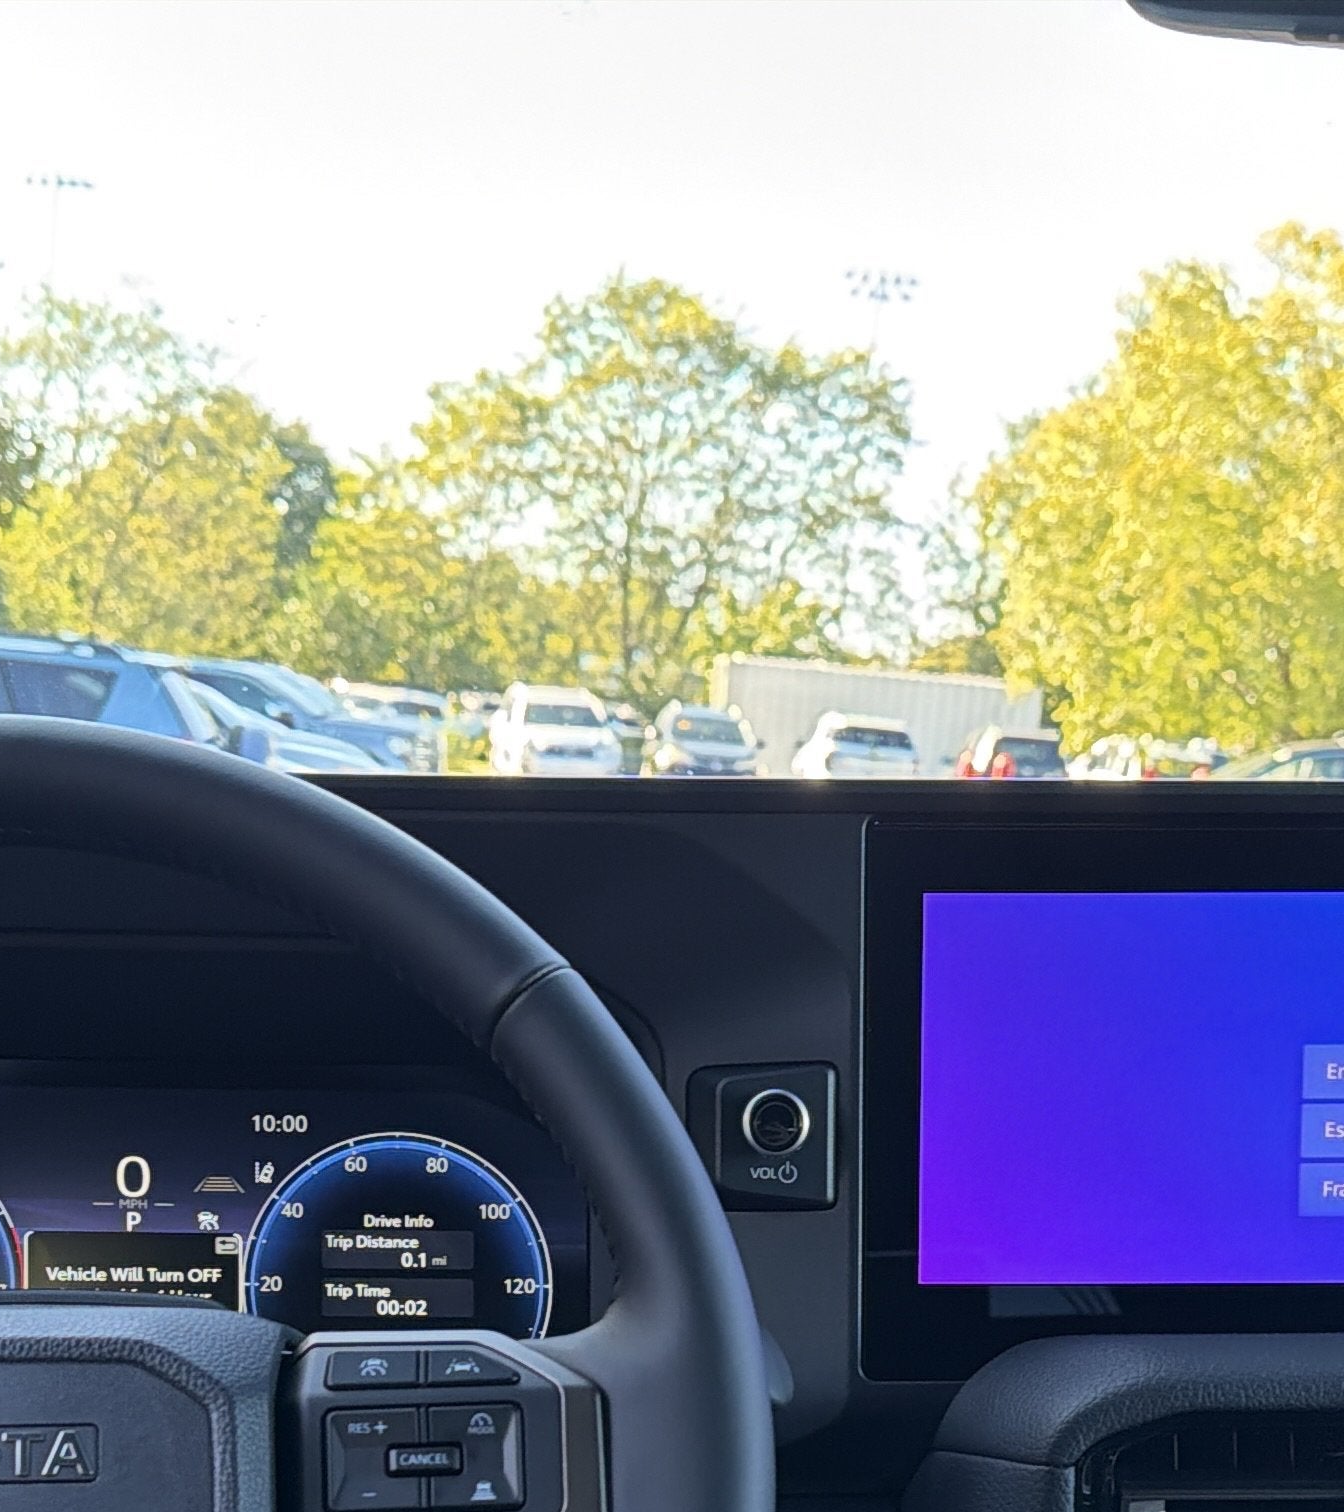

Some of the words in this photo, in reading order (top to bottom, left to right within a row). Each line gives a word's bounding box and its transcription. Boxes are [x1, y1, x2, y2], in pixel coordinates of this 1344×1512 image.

[251, 1114, 308, 1133] 10:00
[344, 1156, 368, 1174] 60
[425, 1157, 449, 1174] 80
[750, 1167, 777, 1180] VOL
[116, 1155, 151, 1198] 0
[118, 1199, 149, 1210] MPH
[281, 1201, 304, 1219] 40
[478, 1203, 511, 1221] 100
[126, 1211, 142, 1232] P
[364, 1213, 401, 1228] Drive
[403, 1213, 434, 1228] Info
[325, 1234, 354, 1252] Trip
[355, 1234, 419, 1250] Distance
[400, 1252, 428, 1268] 0.1
[431, 1255, 448, 1267] mi
[45, 1266, 108, 1282] Vehicle
[109, 1266, 145, 1282] Will
[146, 1267, 185, 1283] Turn
[187, 1268, 223, 1283] OFF
[259, 1275, 283, 1293] 20
[325, 1283, 353, 1300] Trip
[354, 1283, 391, 1299] Time
[503, 1278, 536, 1295] 120
[376, 1300, 428, 1317] 00:02
[398, 1452, 449, 1466] CANCEL
